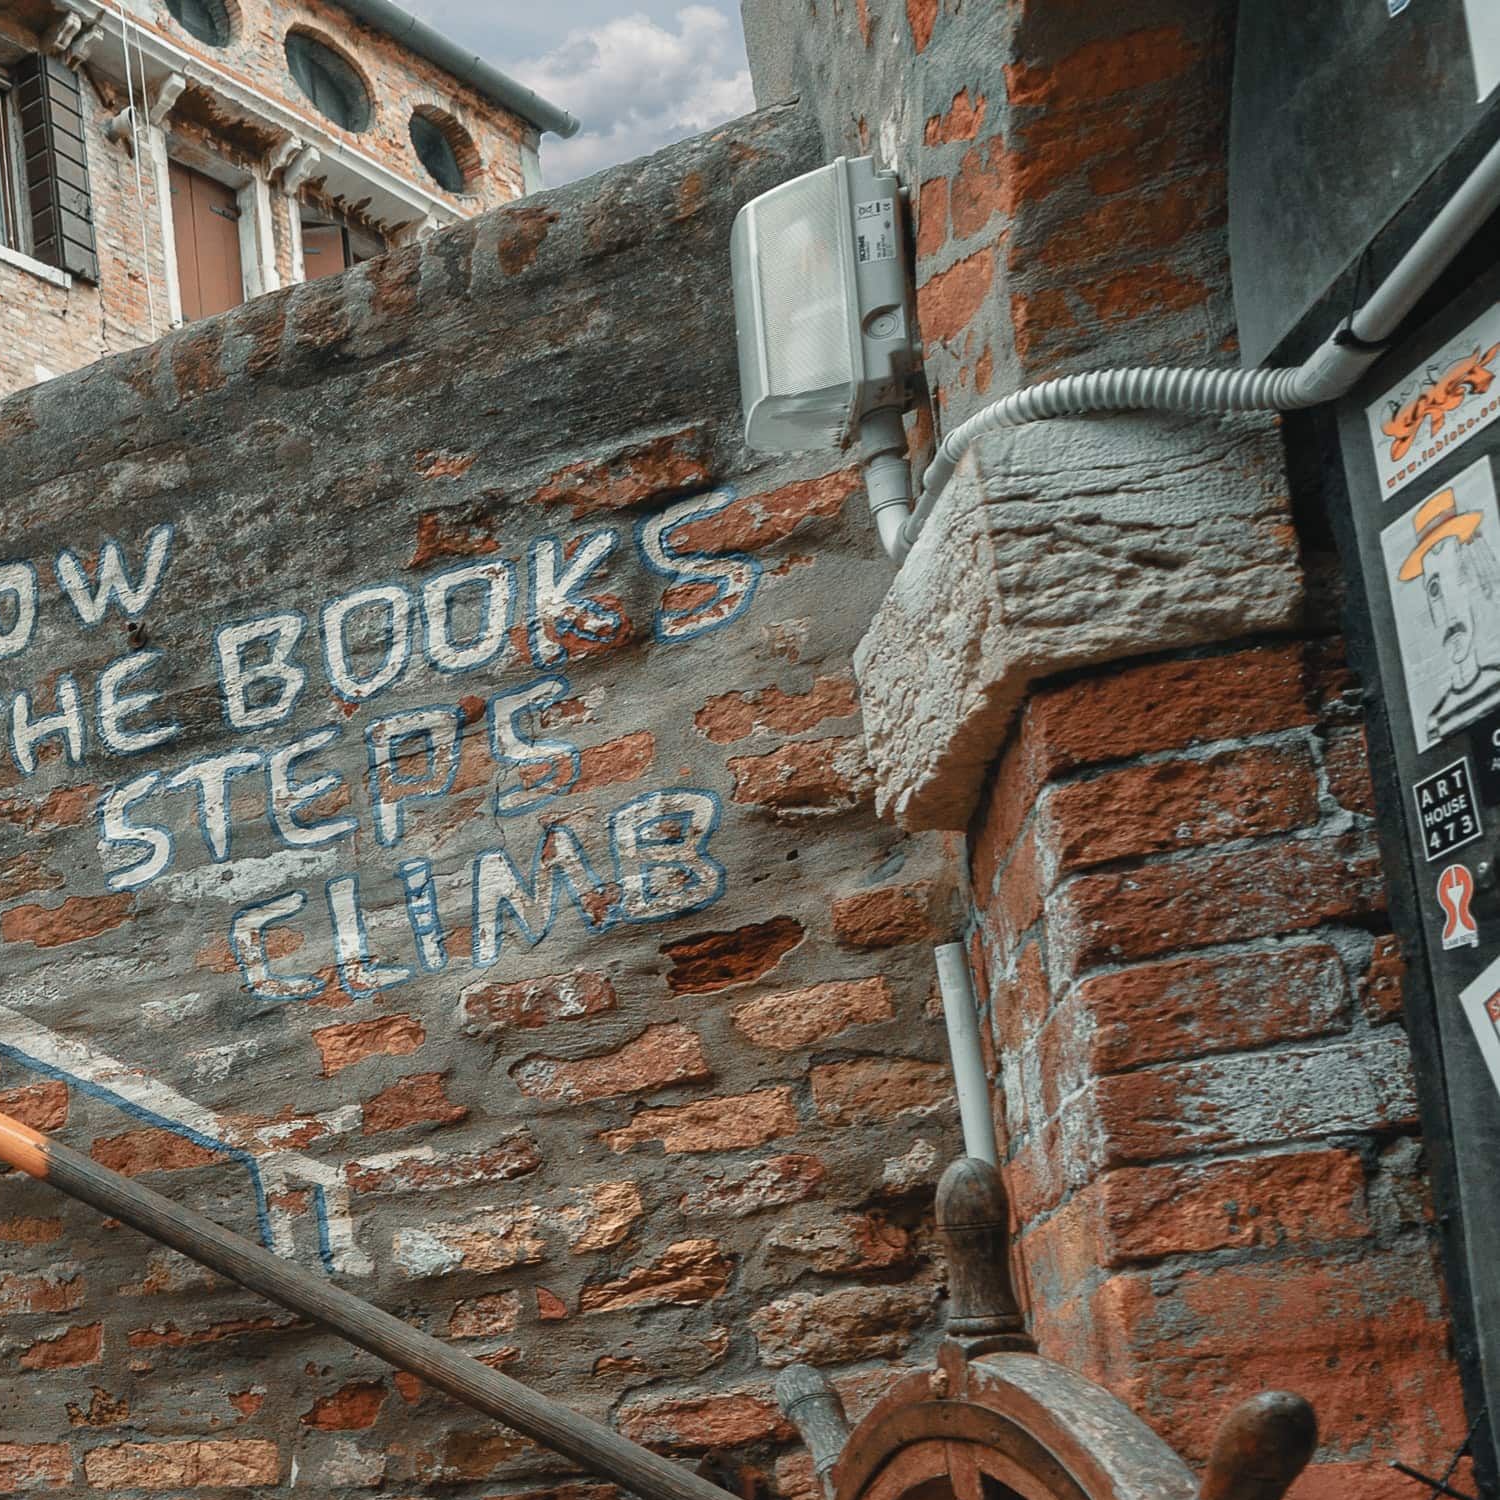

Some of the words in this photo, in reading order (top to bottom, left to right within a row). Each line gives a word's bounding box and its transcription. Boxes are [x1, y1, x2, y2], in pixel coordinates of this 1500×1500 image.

[218, 489, 761, 732] BOOKS
[100, 675, 582, 892] STEPS
[1419, 769, 1464, 810] ART
[1424, 792, 1469, 831] HOUSE
[232, 787, 727, 1004] CLIMB
